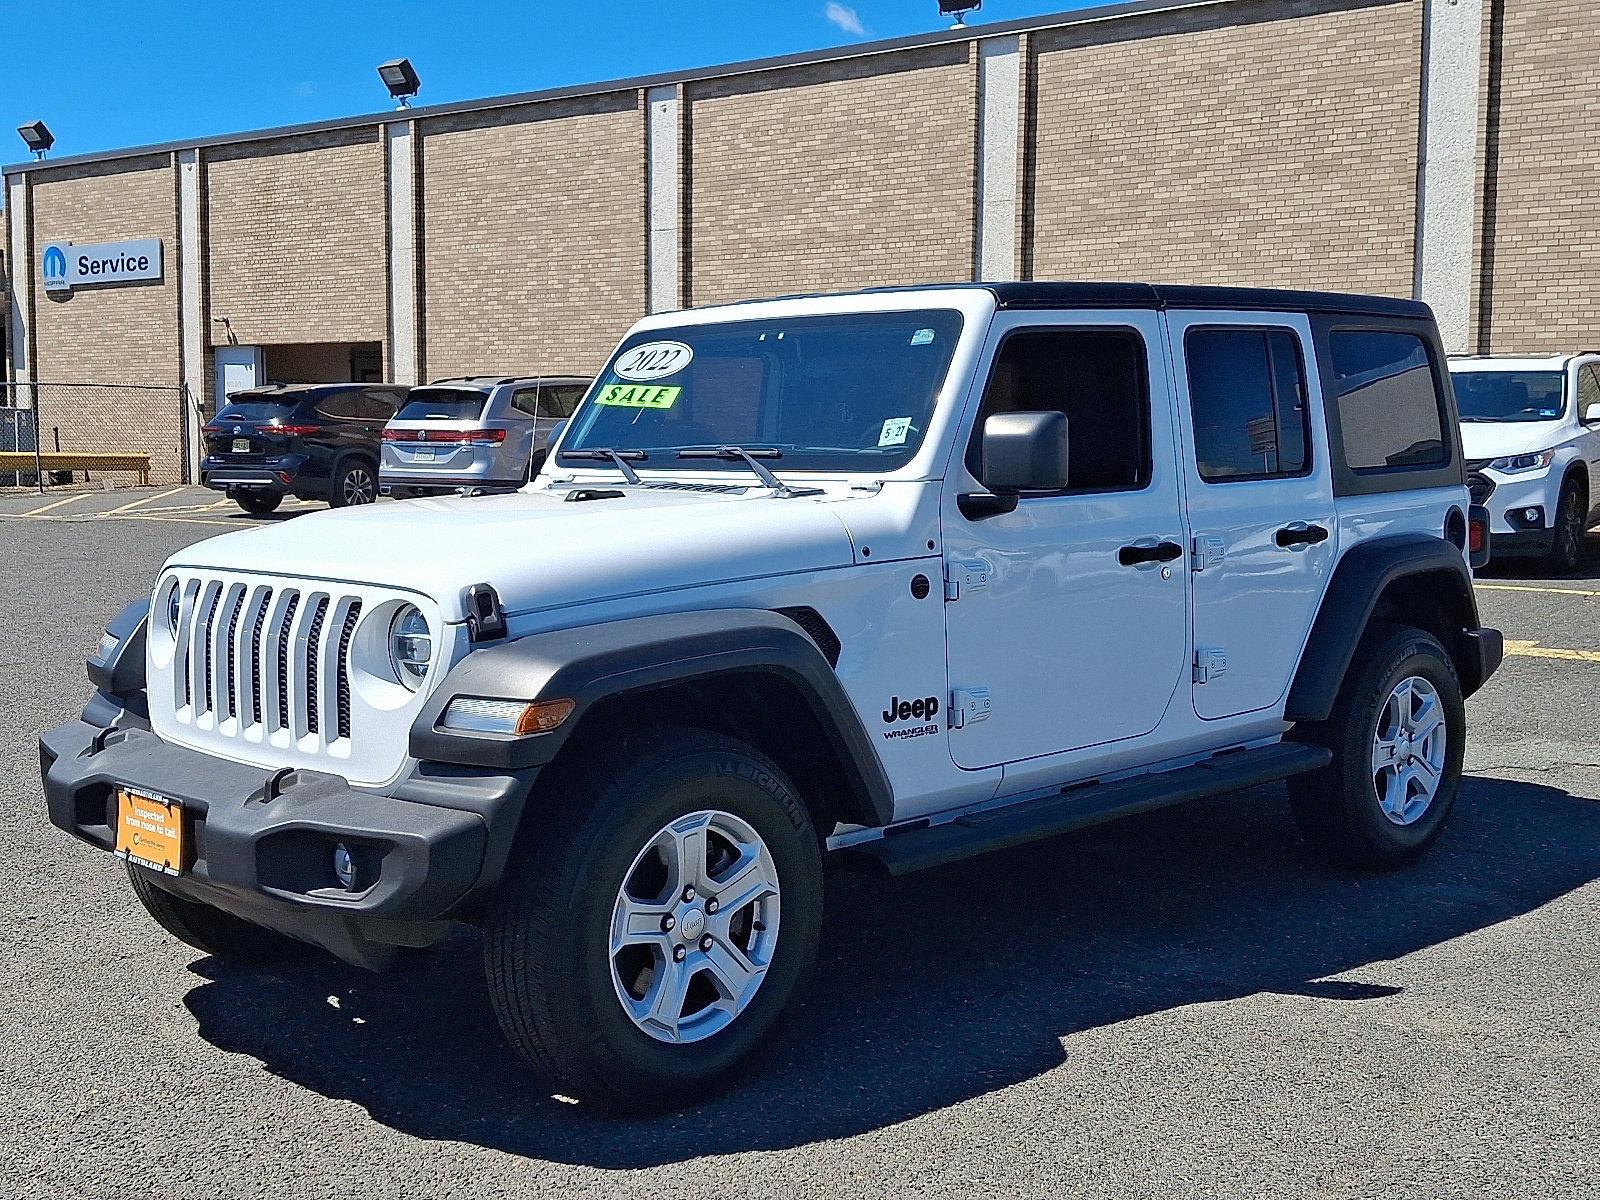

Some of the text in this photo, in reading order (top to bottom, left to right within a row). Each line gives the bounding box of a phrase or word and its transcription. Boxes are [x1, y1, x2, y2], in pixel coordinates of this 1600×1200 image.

[78, 252, 149, 276] Service
[622, 349, 682, 372] 2022
[605, 386, 670, 403] SALE
[884, 425, 906, 439] 5 27
[882, 696, 939, 723] Jeep
[883, 724, 939, 740] WRANGLER
[735, 761, 804, 831] MICHELIN
[125, 814, 141, 828] from
[141, 821, 156, 833] nose
[157, 825, 164, 835] to
[134, 805, 165, 824] Inspected
[128, 855, 163, 872] AUTOLAND
